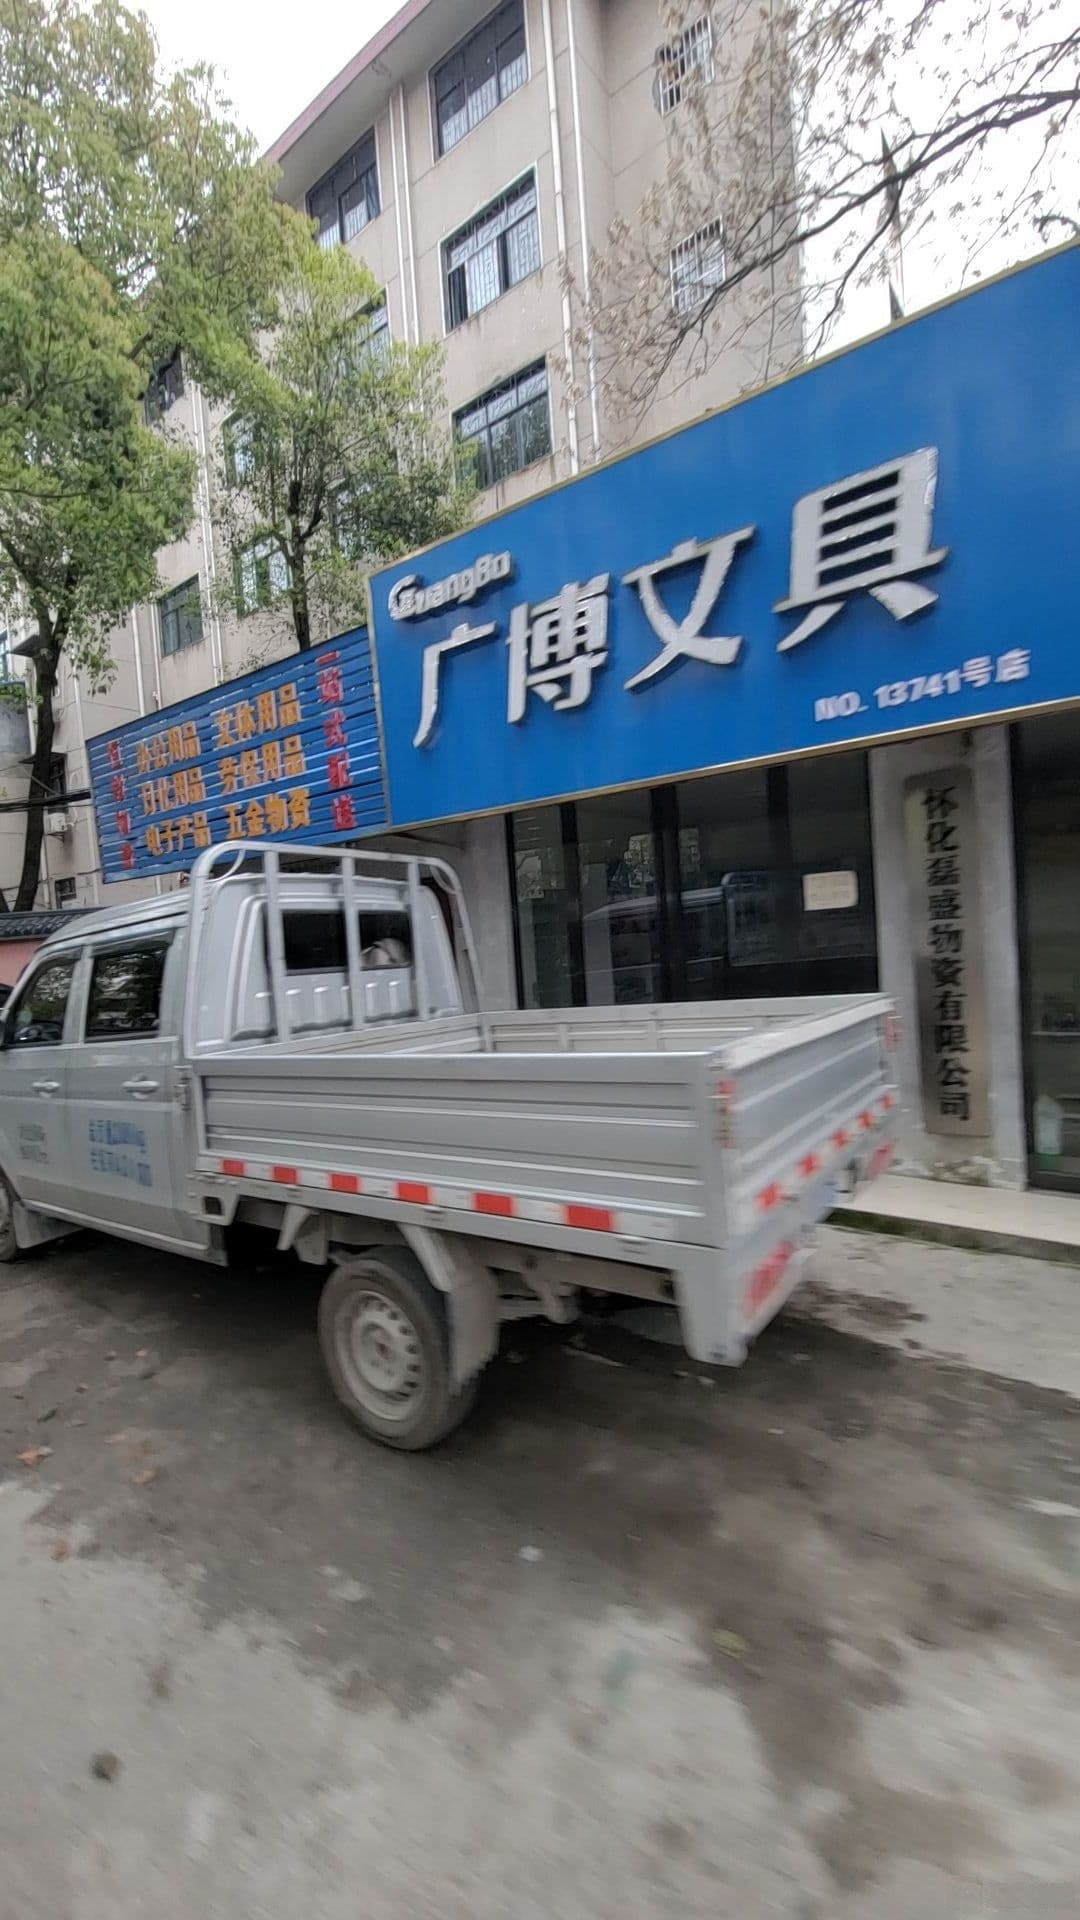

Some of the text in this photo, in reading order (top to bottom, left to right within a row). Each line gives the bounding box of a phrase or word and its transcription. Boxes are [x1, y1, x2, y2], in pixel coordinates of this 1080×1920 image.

[413, 445, 948, 749] 广博文具
[814, 648, 1031, 722] NO. 13741号店
[136, 683, 302, 774] 办公用品 文体用品
[315, 650, 357, 831] 一站式配送
[141, 735, 306, 816] 日化用品 劳保用品
[144, 787, 311, 857] 电子产品 五金物资
